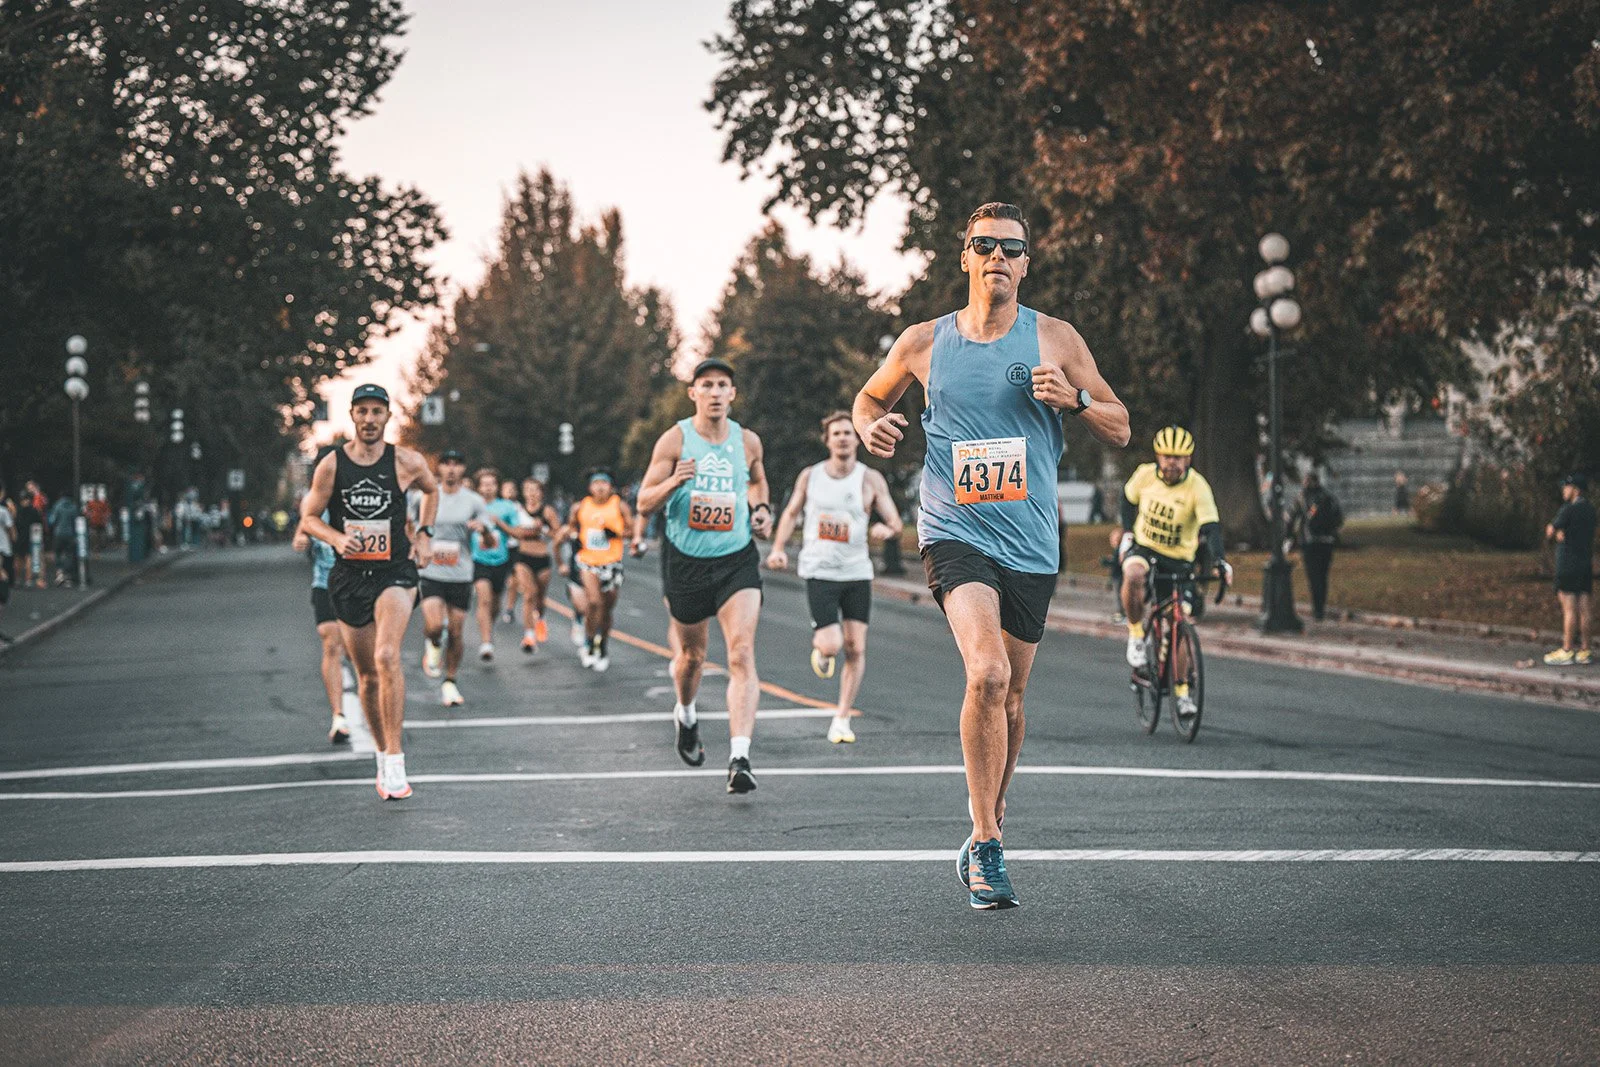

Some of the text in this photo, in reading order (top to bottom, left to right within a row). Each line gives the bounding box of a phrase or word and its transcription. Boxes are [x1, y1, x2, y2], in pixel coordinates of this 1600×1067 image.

[1010, 370, 1026, 381] ERC
[695, 475, 733, 491] M2M
[957, 460, 1023, 493] 4374
[350, 495, 382, 506] M2M
[979, 493, 1005, 501] MATTHEW
[692, 505, 732, 525] 5225
